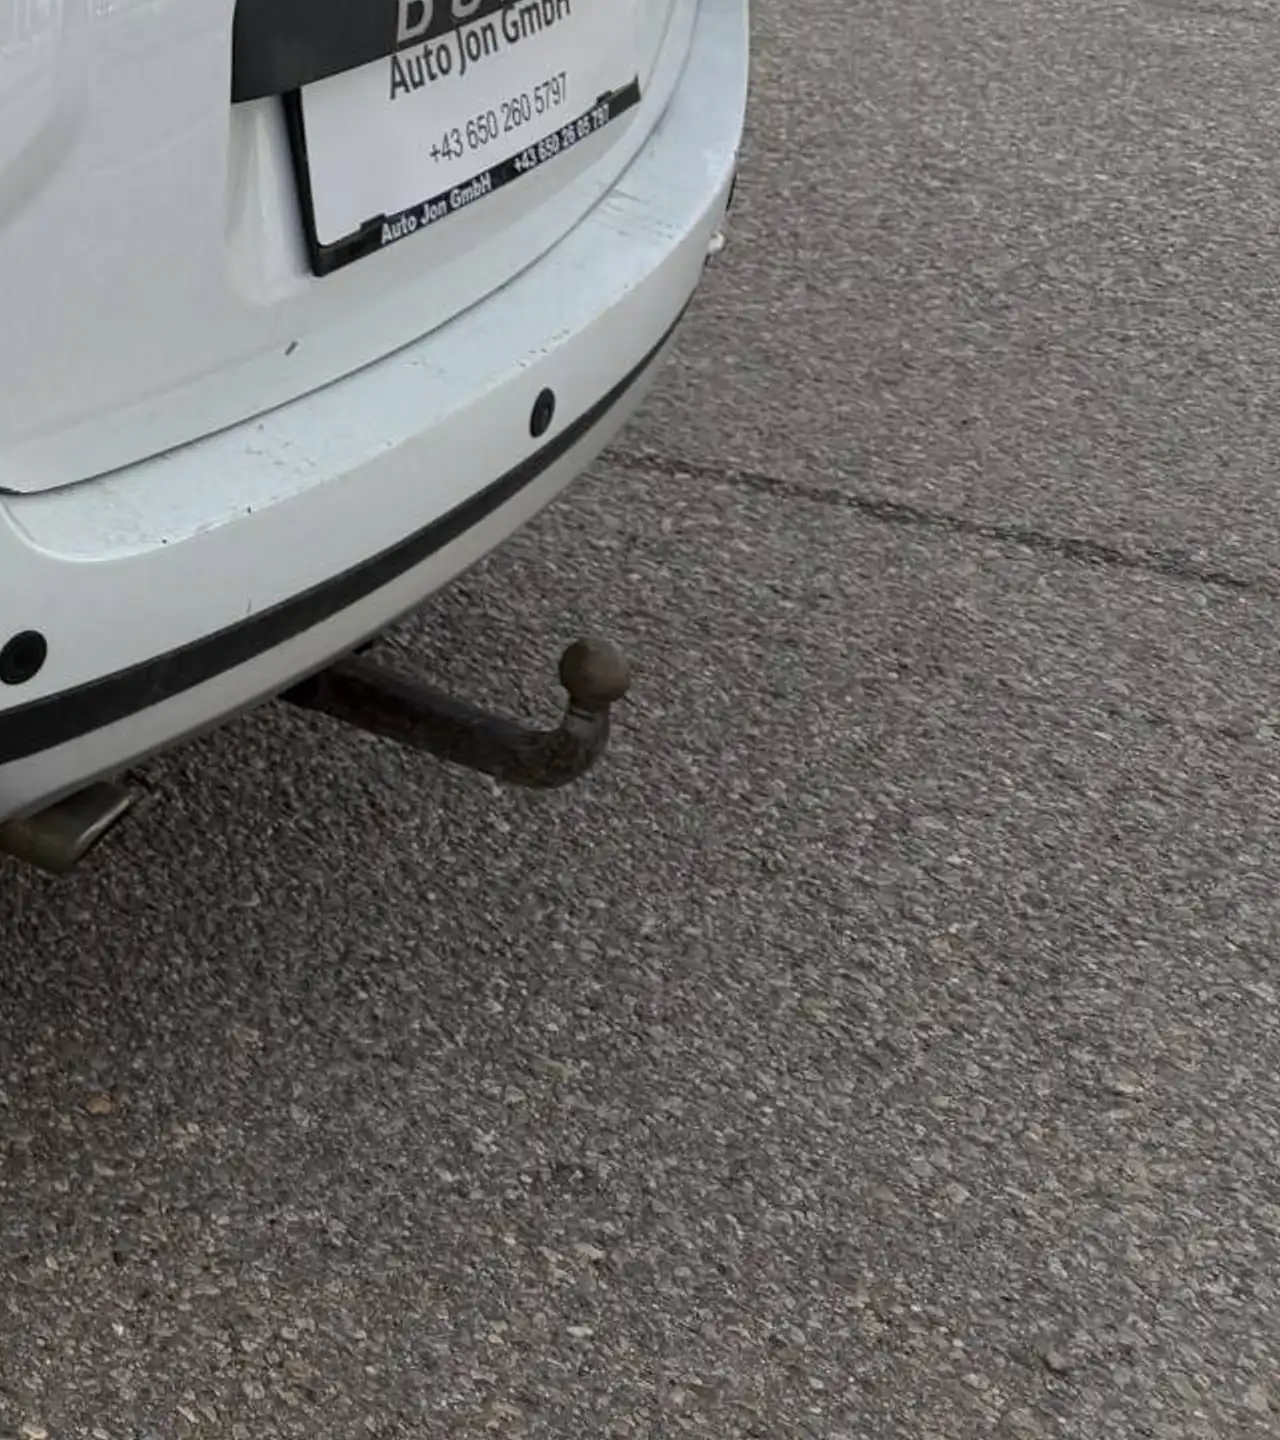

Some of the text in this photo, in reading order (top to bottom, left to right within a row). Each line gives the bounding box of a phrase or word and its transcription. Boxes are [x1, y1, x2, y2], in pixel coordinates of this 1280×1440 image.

[389, 44, 453, 100] Auto
[454, 21, 499, 77] Jon
[429, 71, 567, 162] +43 650 260 5797
[381, 216, 418, 244] Auto
[421, 200, 448, 225] Jon
[450, 171, 493, 208] GmbH
